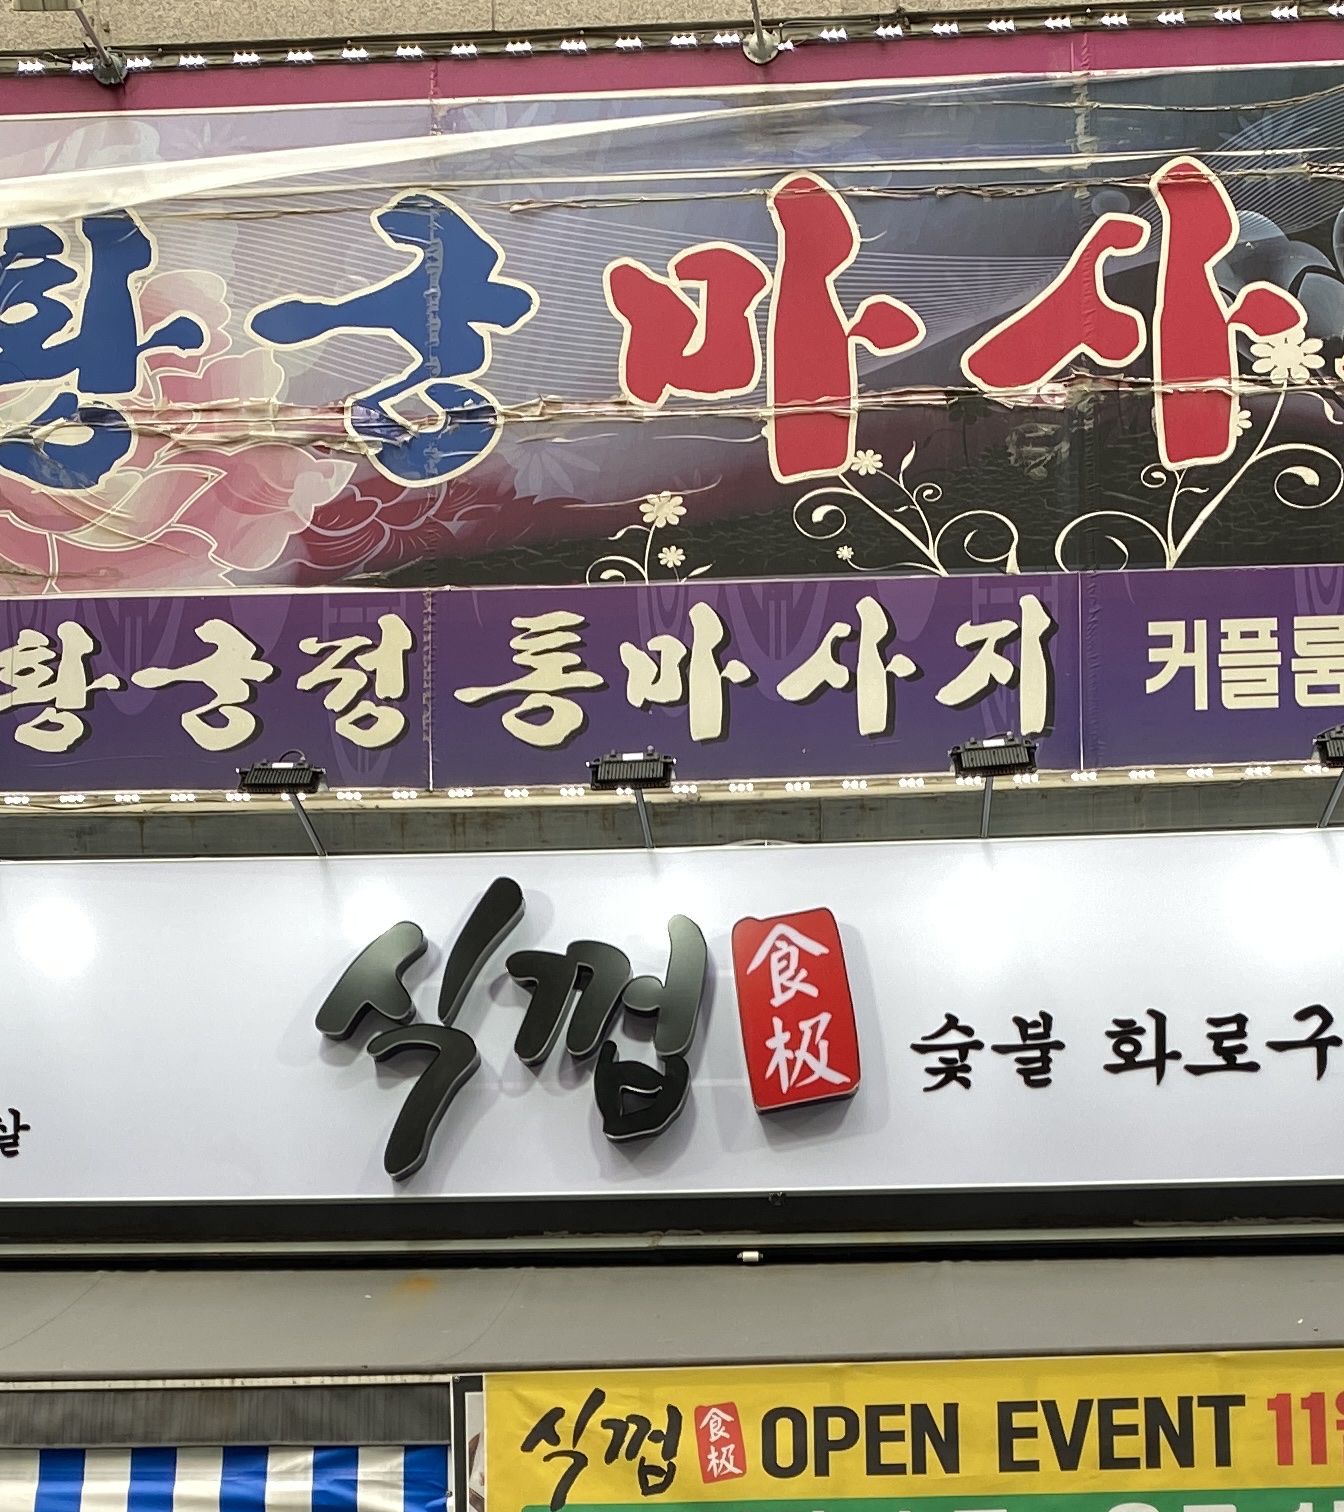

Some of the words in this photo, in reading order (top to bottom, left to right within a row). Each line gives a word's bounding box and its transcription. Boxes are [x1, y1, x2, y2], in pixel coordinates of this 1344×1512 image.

[314, 875, 709, 1184] 식껍
[910, 1011, 1065, 1093] 숯불
[520, 1388, 681, 1511] 식껍
[761, 1402, 960, 1480] OPEN
[996, 1393, 1245, 1473] EVENT
